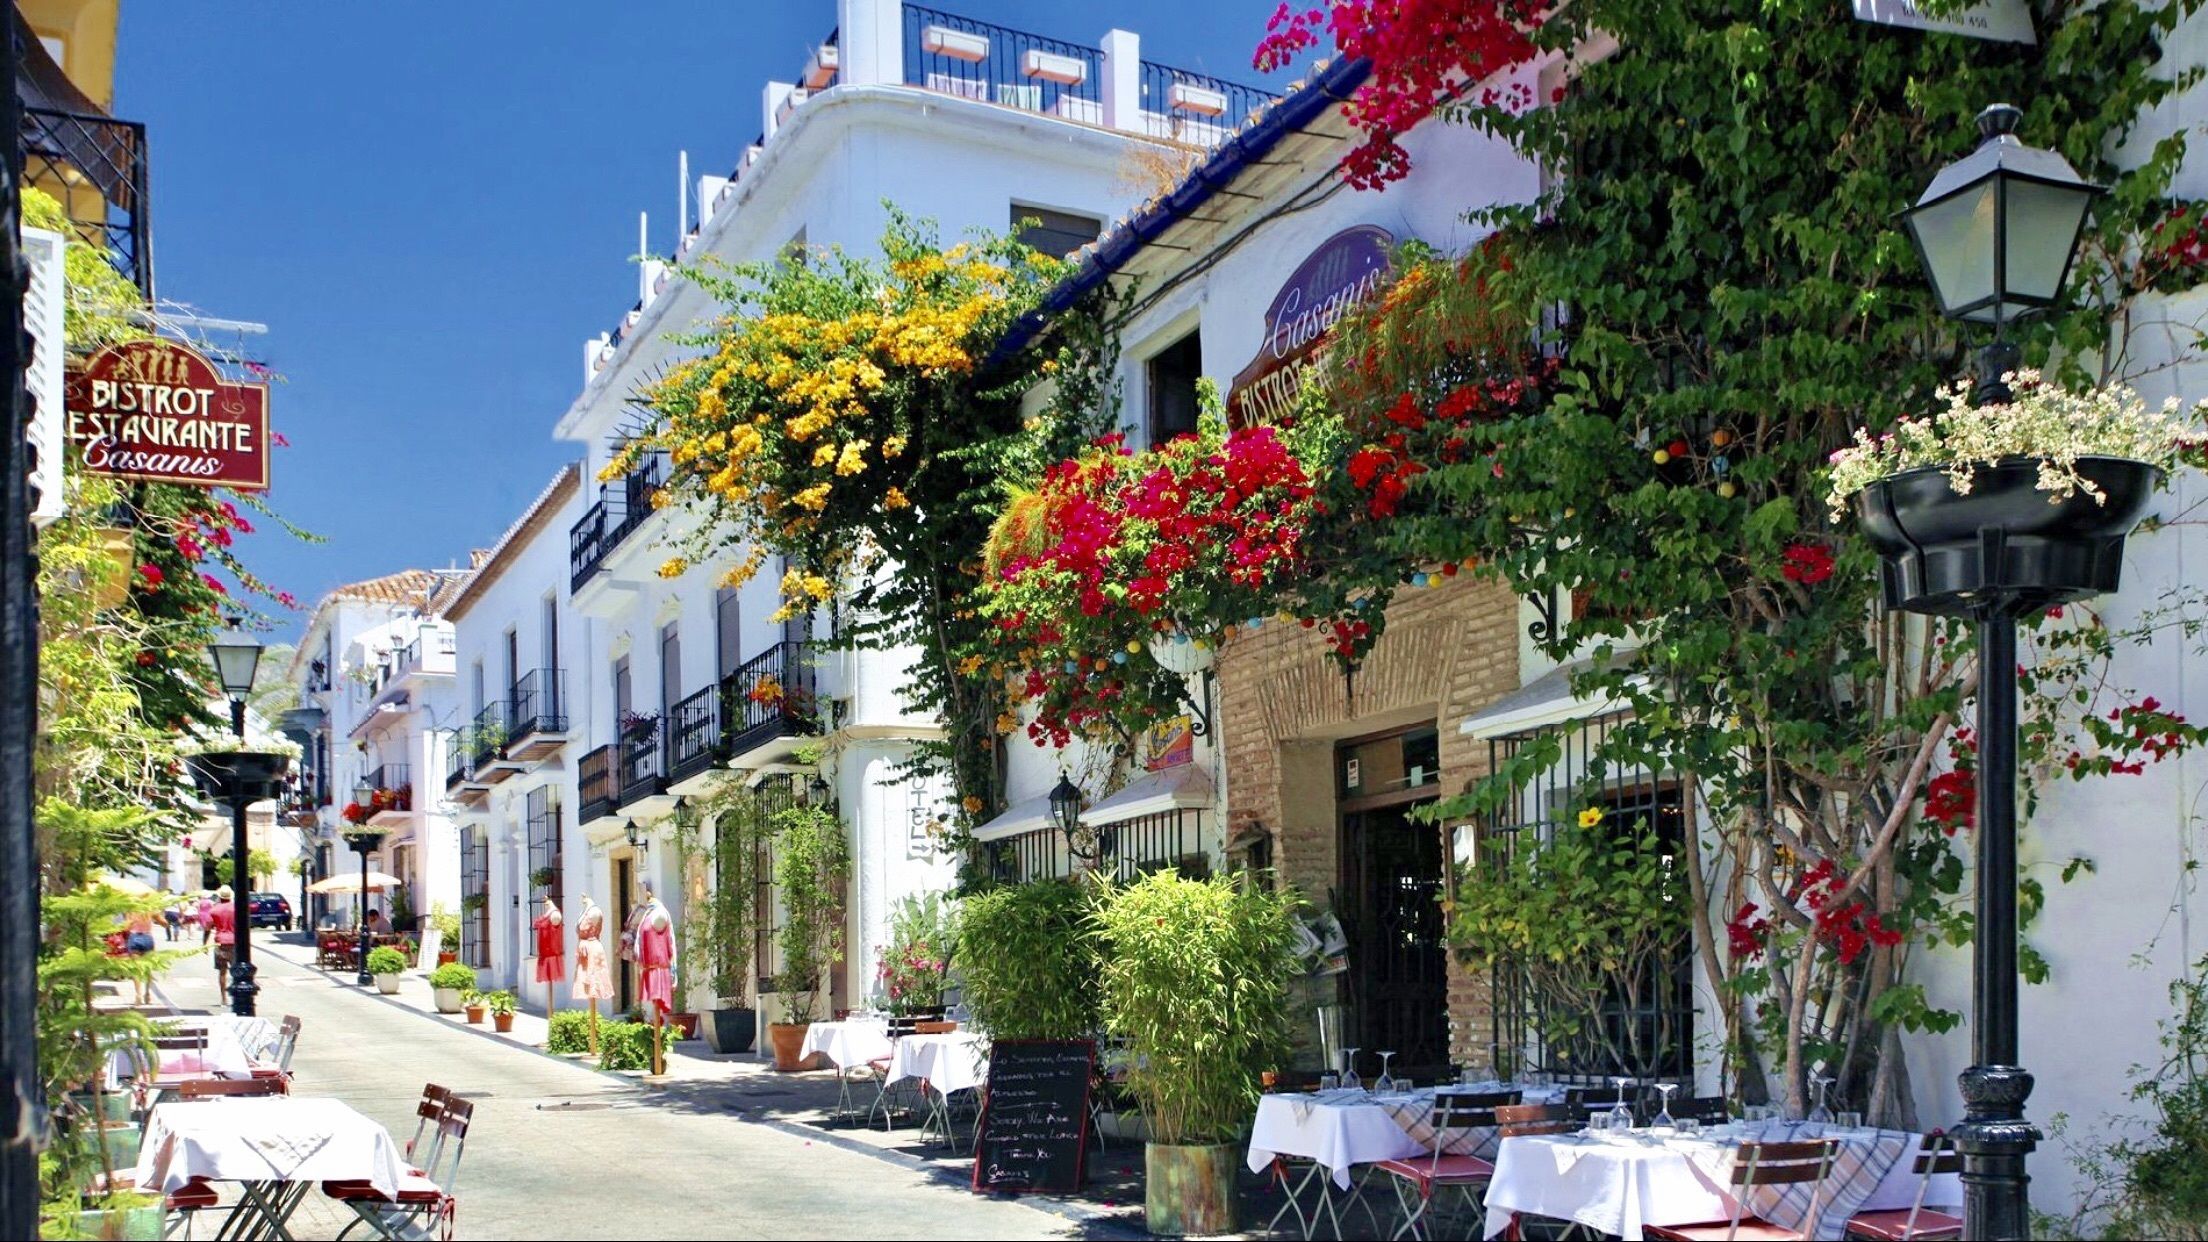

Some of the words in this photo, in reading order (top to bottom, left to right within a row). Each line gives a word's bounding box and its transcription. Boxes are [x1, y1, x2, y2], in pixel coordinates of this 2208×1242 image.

[1273, 256, 1380, 360] Casanis
[92, 379, 215, 417] BISTROT
[1240, 358, 1303, 429] BISTROT
[64, 410, 253, 453] ESTAURANTE
[83, 435, 224, 477] Casanis
